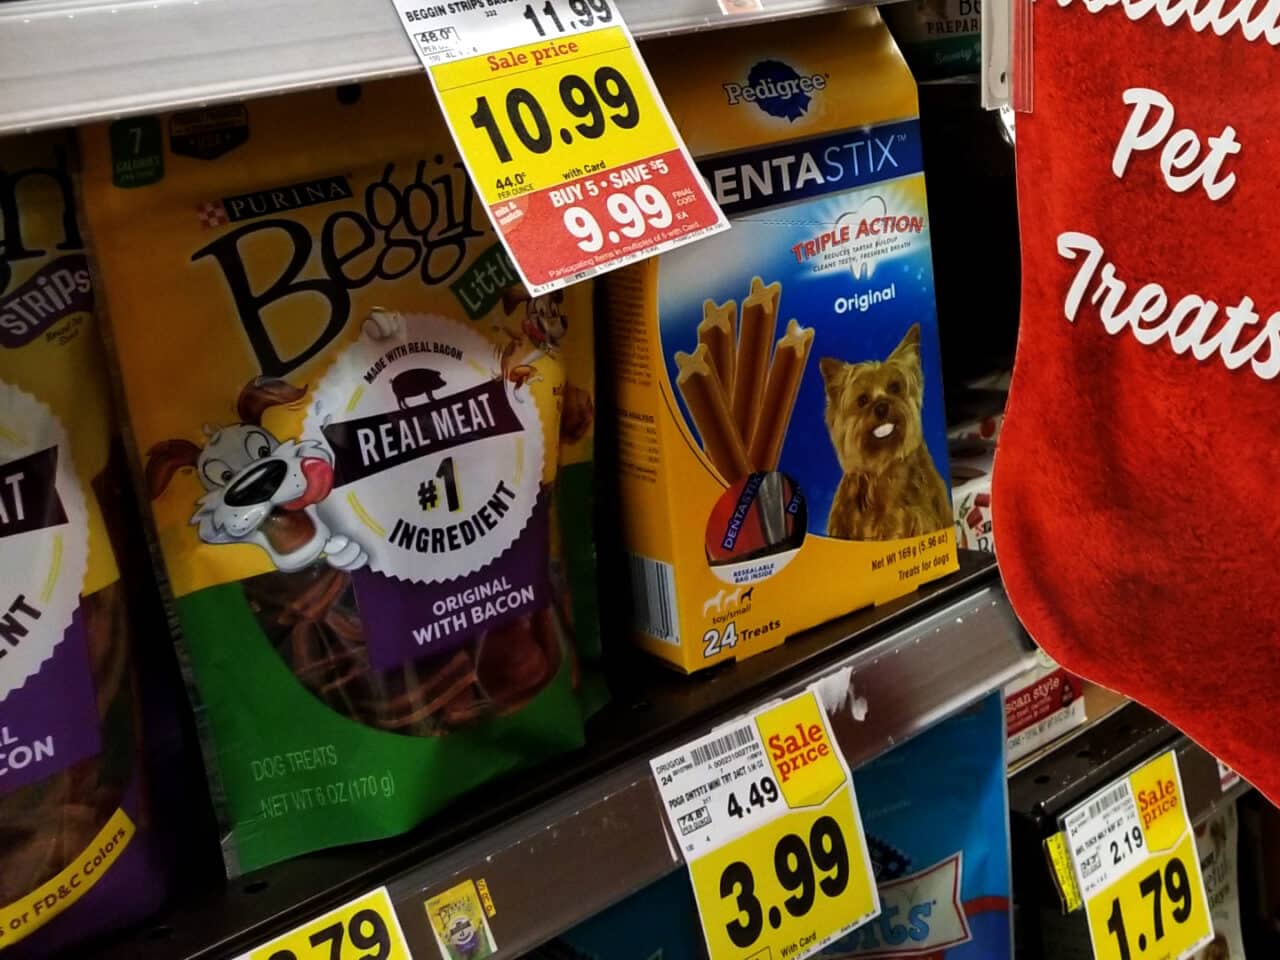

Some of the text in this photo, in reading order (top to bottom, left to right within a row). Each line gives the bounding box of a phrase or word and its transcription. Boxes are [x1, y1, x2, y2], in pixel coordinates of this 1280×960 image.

[405, 5, 448, 23] BEGGIN
[486, 40, 579, 73] Sale price
[723, 72, 828, 106] Pedigree
[470, 66, 641, 165] 10.99
[1111, 87, 1242, 201] Pet
[549, 183, 585, 209] BUY
[585, 180, 600, 197] 5
[608, 164, 653, 190] SAVE
[562, 160, 606, 182] with Card
[704, 134, 900, 206] ENTASTIX
[230, 180, 347, 219] PURINA
[563, 184, 674, 253] 9.99
[791, 215, 924, 264] TRIPLE ACTION
[834, 282, 896, 318] Original
[363, 341, 464, 384] MADE WITH REAL BACON
[356, 393, 496, 467] REAL MEAT
[417, 456, 463, 513] #1
[388, 480, 517, 554] INGREDIENT
[722, 472, 762, 552] DENTASTIX
[732, 562, 776, 578] RESEALABLE
[733, 568, 774, 584] BAG INSIDE
[871, 553, 898, 572] Net Wt
[897, 552, 950, 582] Treats for dogs
[412, 585, 536, 647] WITH BACON
[431, 576, 513, 617] ORIGINAL
[711, 604, 752, 625] toy/small
[703, 618, 781, 659] 24 Treats
[768, 723, 824, 762] Sale
[776, 742, 830, 784] price
[251, 744, 338, 783] DOG TREATS
[260, 790, 292, 820] NET
[727, 776, 779, 820] 4.49
[1137, 778, 1176, 813] Sale
[1142, 794, 1178, 830] price
[1109, 825, 1144, 866] 2.19
[9, 826, 126, 932] or FD&C Colors
[719, 815, 850, 949] 3.99
[1106, 857, 1192, 960] 1.79
[780, 931, 817, 958] With Card
